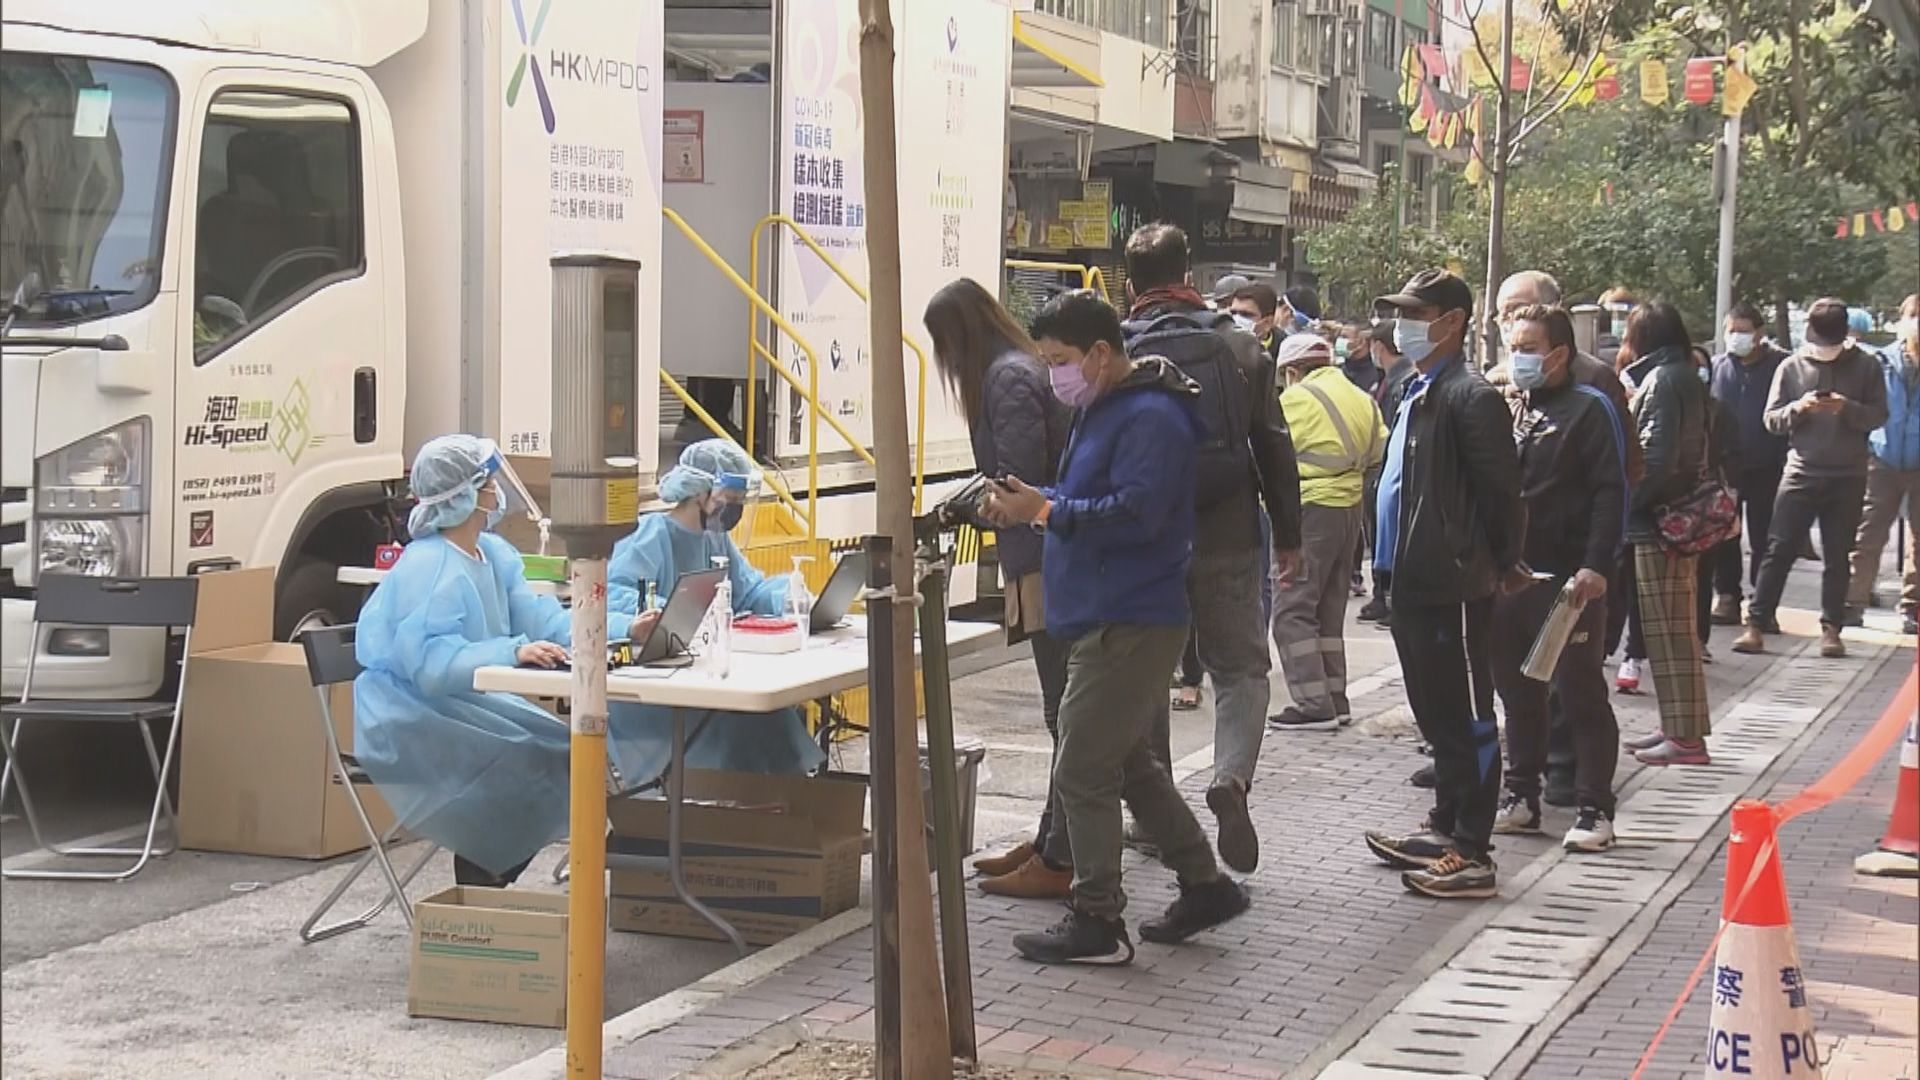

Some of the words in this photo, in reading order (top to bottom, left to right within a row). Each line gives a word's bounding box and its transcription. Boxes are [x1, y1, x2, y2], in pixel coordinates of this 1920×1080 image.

[551, 49, 649, 92] HKMPDC
[795, 122, 831, 151] 新冠病毒
[794, 152, 844, 190] 樣本收集
[793, 191, 844, 226] 檢測採樣
[184, 422, 269, 448] Hi-Speed
[183, 486, 262, 501] www.hi-speed.hk
[421, 930, 449, 943] PURE
[450, 933, 492, 945] Comfort
[467, 920, 496, 936] PLUS
[1780, 1029, 1819, 1075] PO
